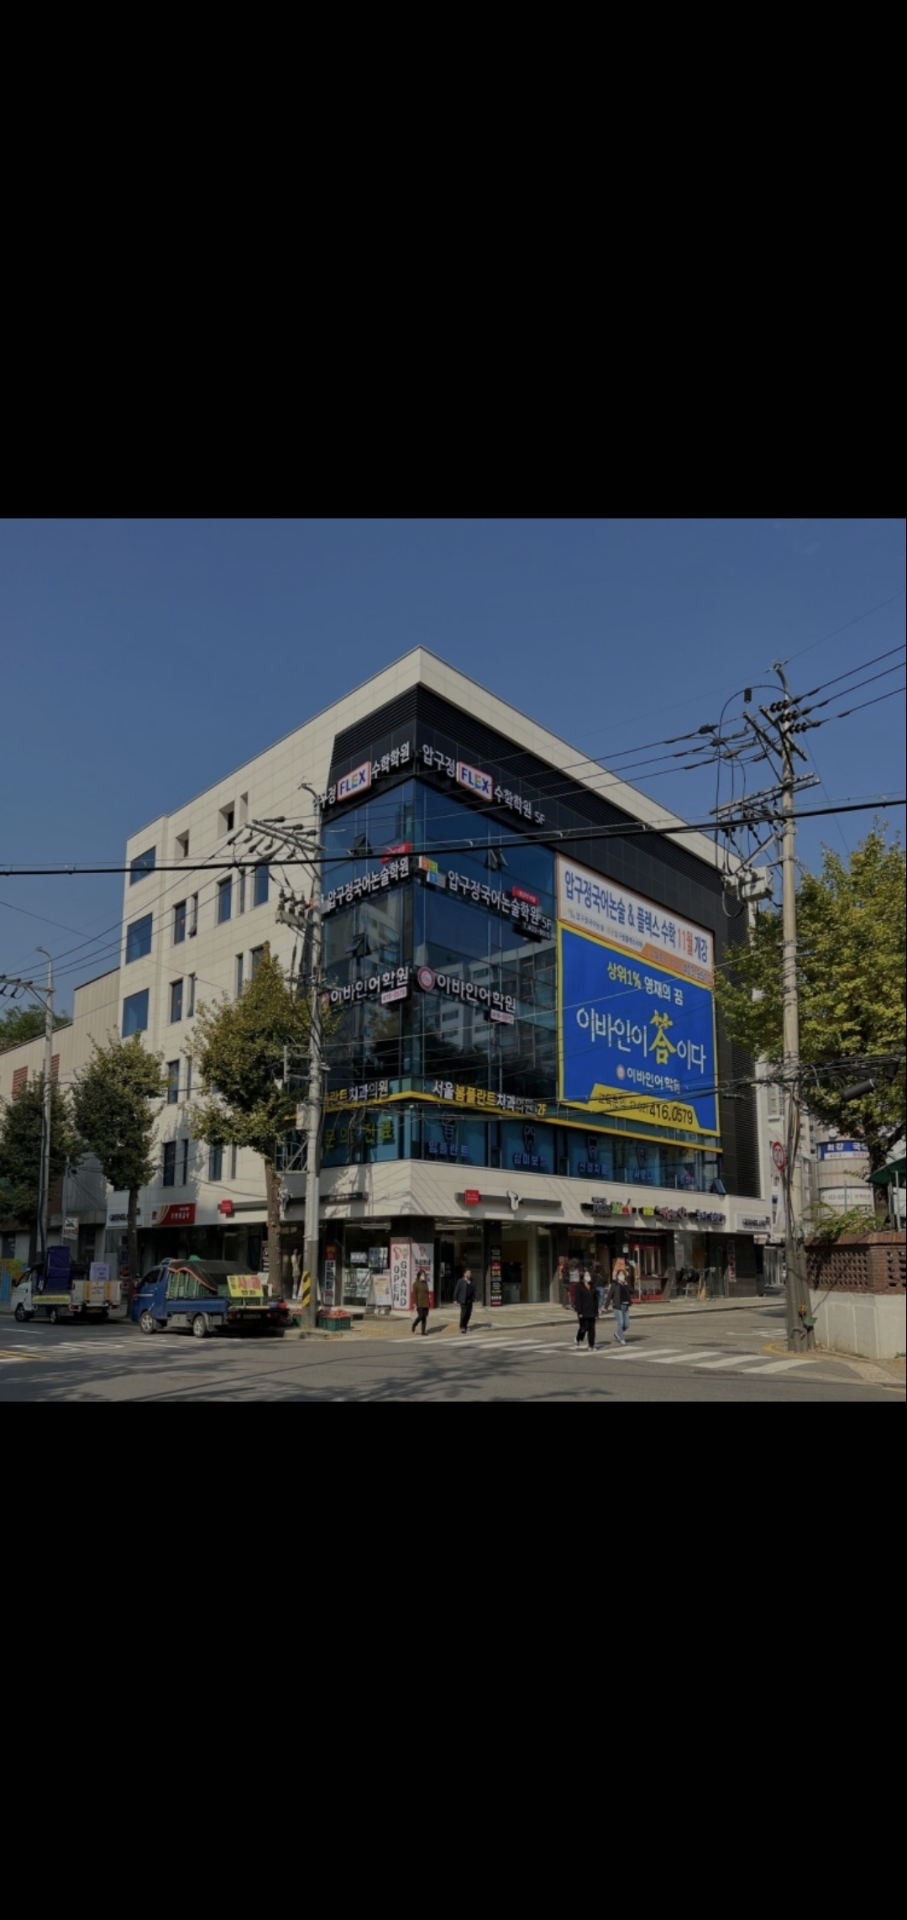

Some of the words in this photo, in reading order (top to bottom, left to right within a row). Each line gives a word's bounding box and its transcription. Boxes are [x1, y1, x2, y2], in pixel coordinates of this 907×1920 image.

[340, 769, 367, 797] FLEX
[372, 741, 410, 780] 수학학원
[422, 744, 455, 778] 압구정
[461, 766, 489, 794] FLEX
[494, 785, 531, 819] 수학학원
[328, 856, 409, 910] 압구정국어논술학원
[448, 870, 541, 926] 압구정국어논술학원
[564, 870, 626, 926] 압구정국어논술
[627, 903, 635, 927] &
[661, 919, 676, 949] 수학
[677, 926, 693, 957] 11월
[694, 936, 708, 964] 개강
[330, 966, 409, 1003] 이바인어학원
[437, 974, 516, 1013] 이바인어학원
[607, 961, 642, 989] 상위1%
[644, 976, 671, 1002] 영재의
[673, 988, 684, 1006] 꿈
[626, 1067, 681, 1094] 이바인어학원
[649, 1103, 693, 1125] 416.0579
[428, 1141, 469, 1157] 임플란트
